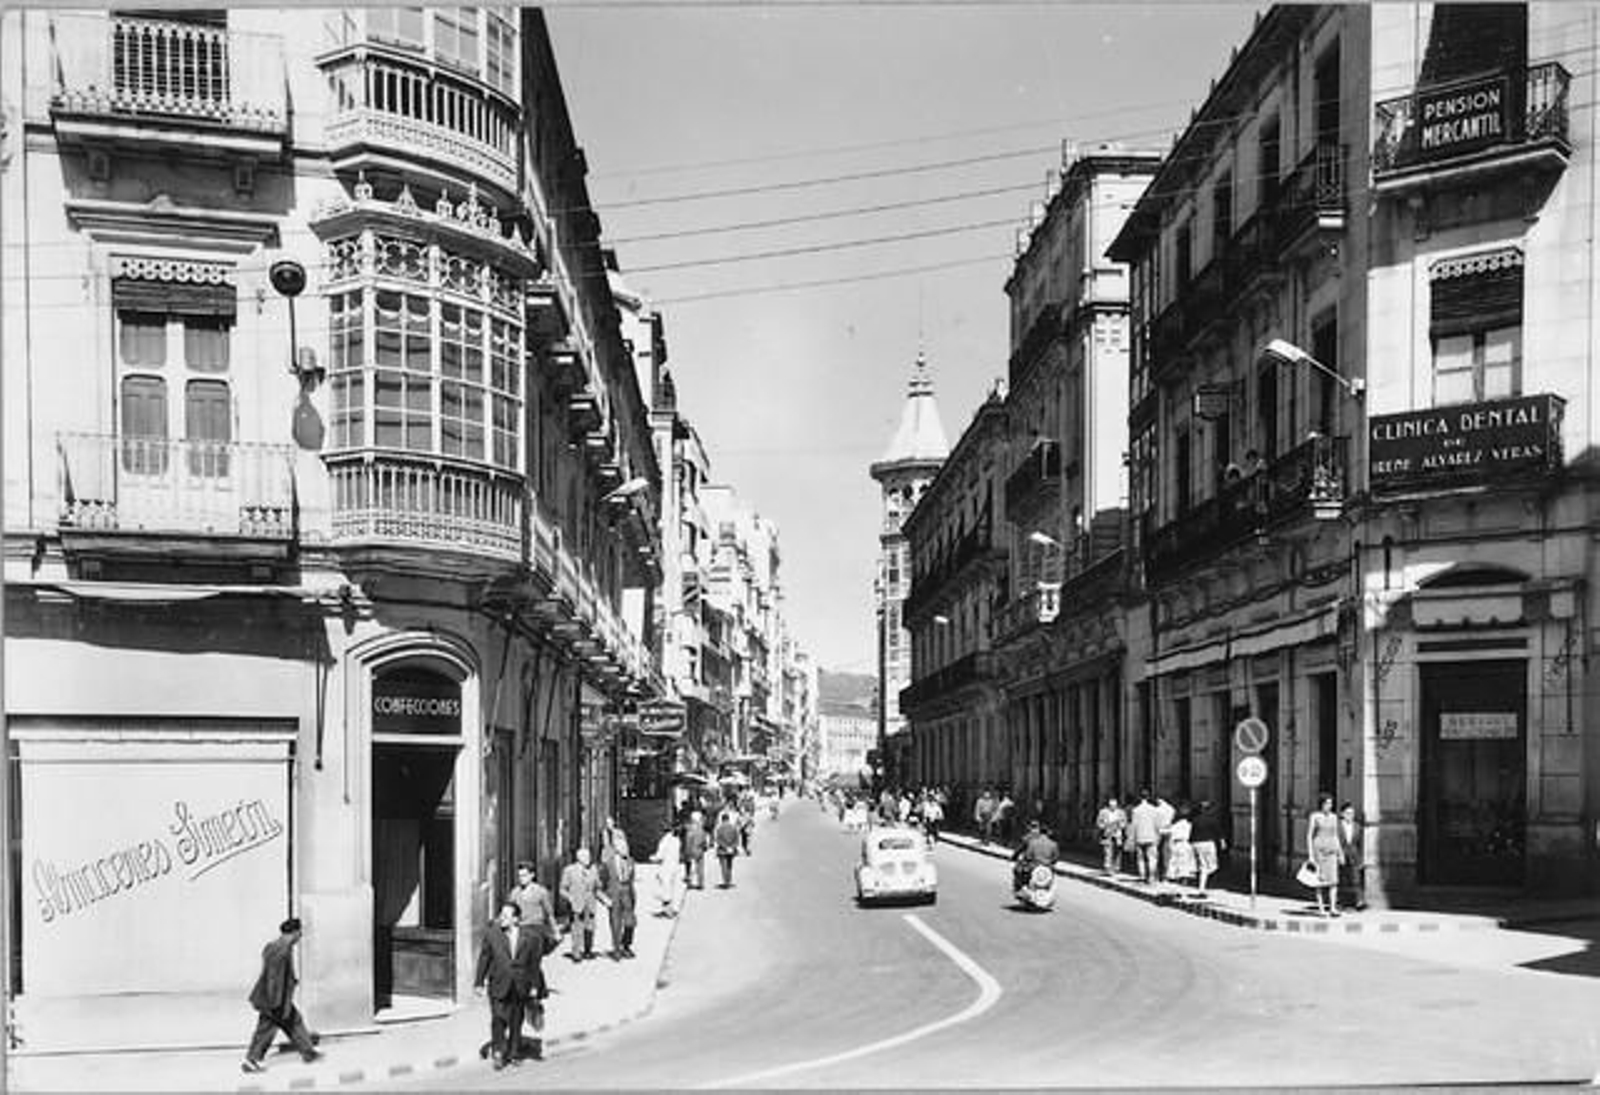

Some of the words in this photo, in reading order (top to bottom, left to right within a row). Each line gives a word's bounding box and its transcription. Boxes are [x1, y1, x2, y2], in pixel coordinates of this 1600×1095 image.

[1424, 88, 1500, 120] PENSION
[1421, 111, 1501, 149] MERCANTIL
[1372, 418, 1449, 440] CLINICA
[1461, 405, 1540, 431] DENTAL
[374, 697, 460, 716] CONFECCIONES
[33, 839, 172, 922] Almacenes
